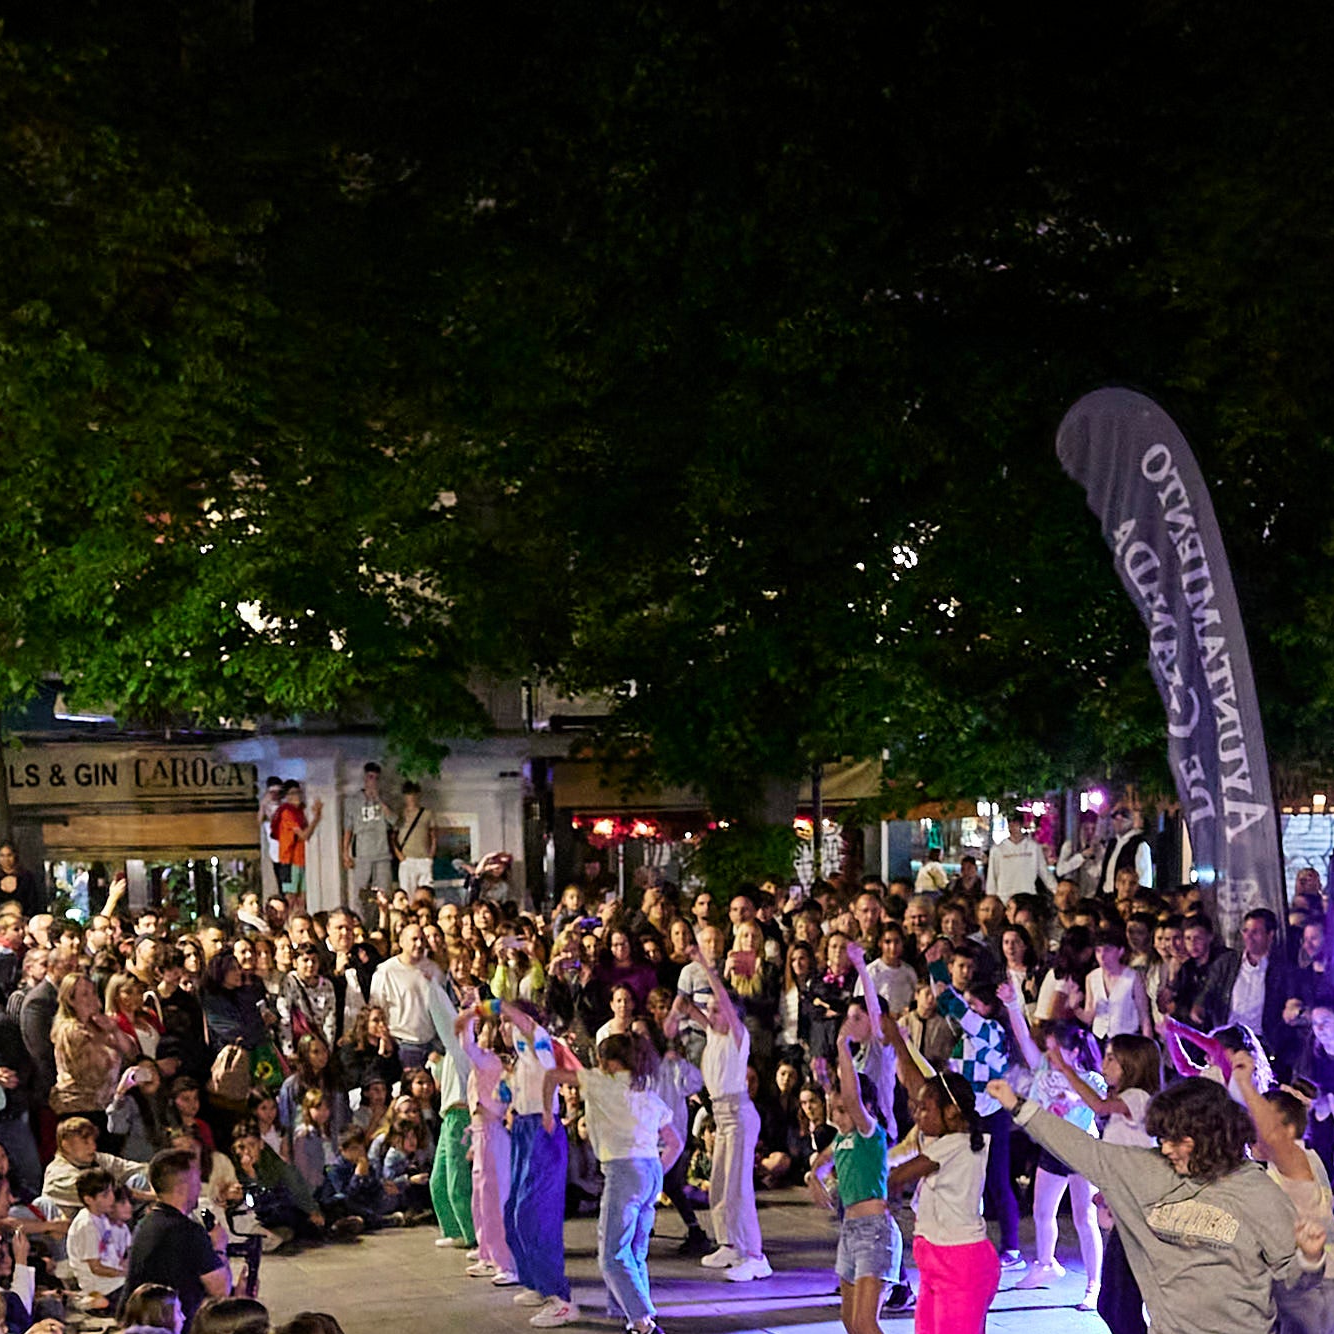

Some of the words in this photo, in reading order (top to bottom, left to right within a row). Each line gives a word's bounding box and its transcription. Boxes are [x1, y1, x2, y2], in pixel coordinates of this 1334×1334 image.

[49, 764, 66, 787] &
[74, 763, 117, 786] GIN
[134, 757, 245, 788] CAROCA
